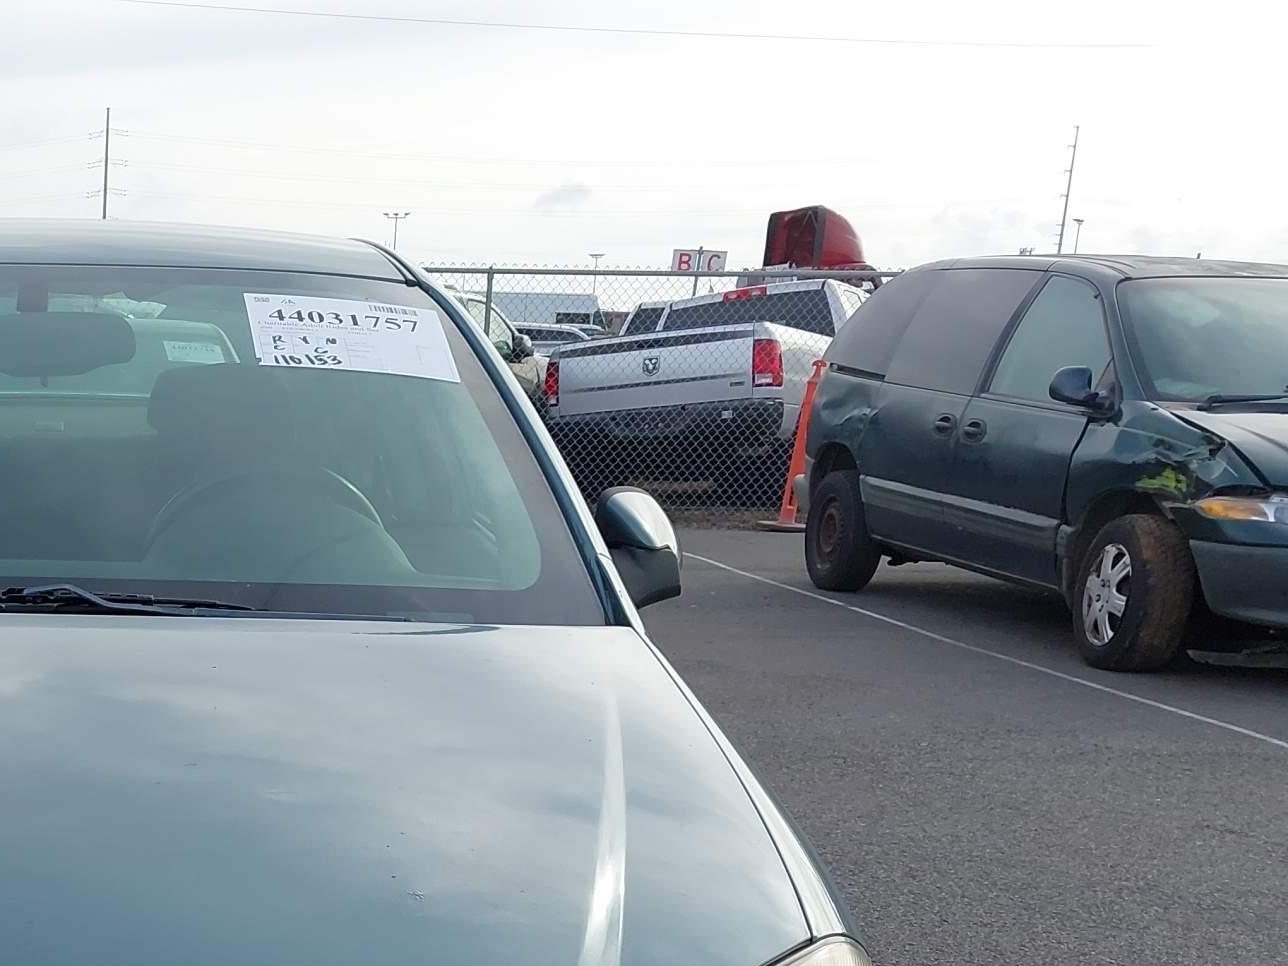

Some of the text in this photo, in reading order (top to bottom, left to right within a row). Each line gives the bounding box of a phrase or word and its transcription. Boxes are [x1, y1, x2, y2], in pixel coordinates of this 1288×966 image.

[678, 252, 721, 271] B C
[268, 308, 419, 334] 44031757
